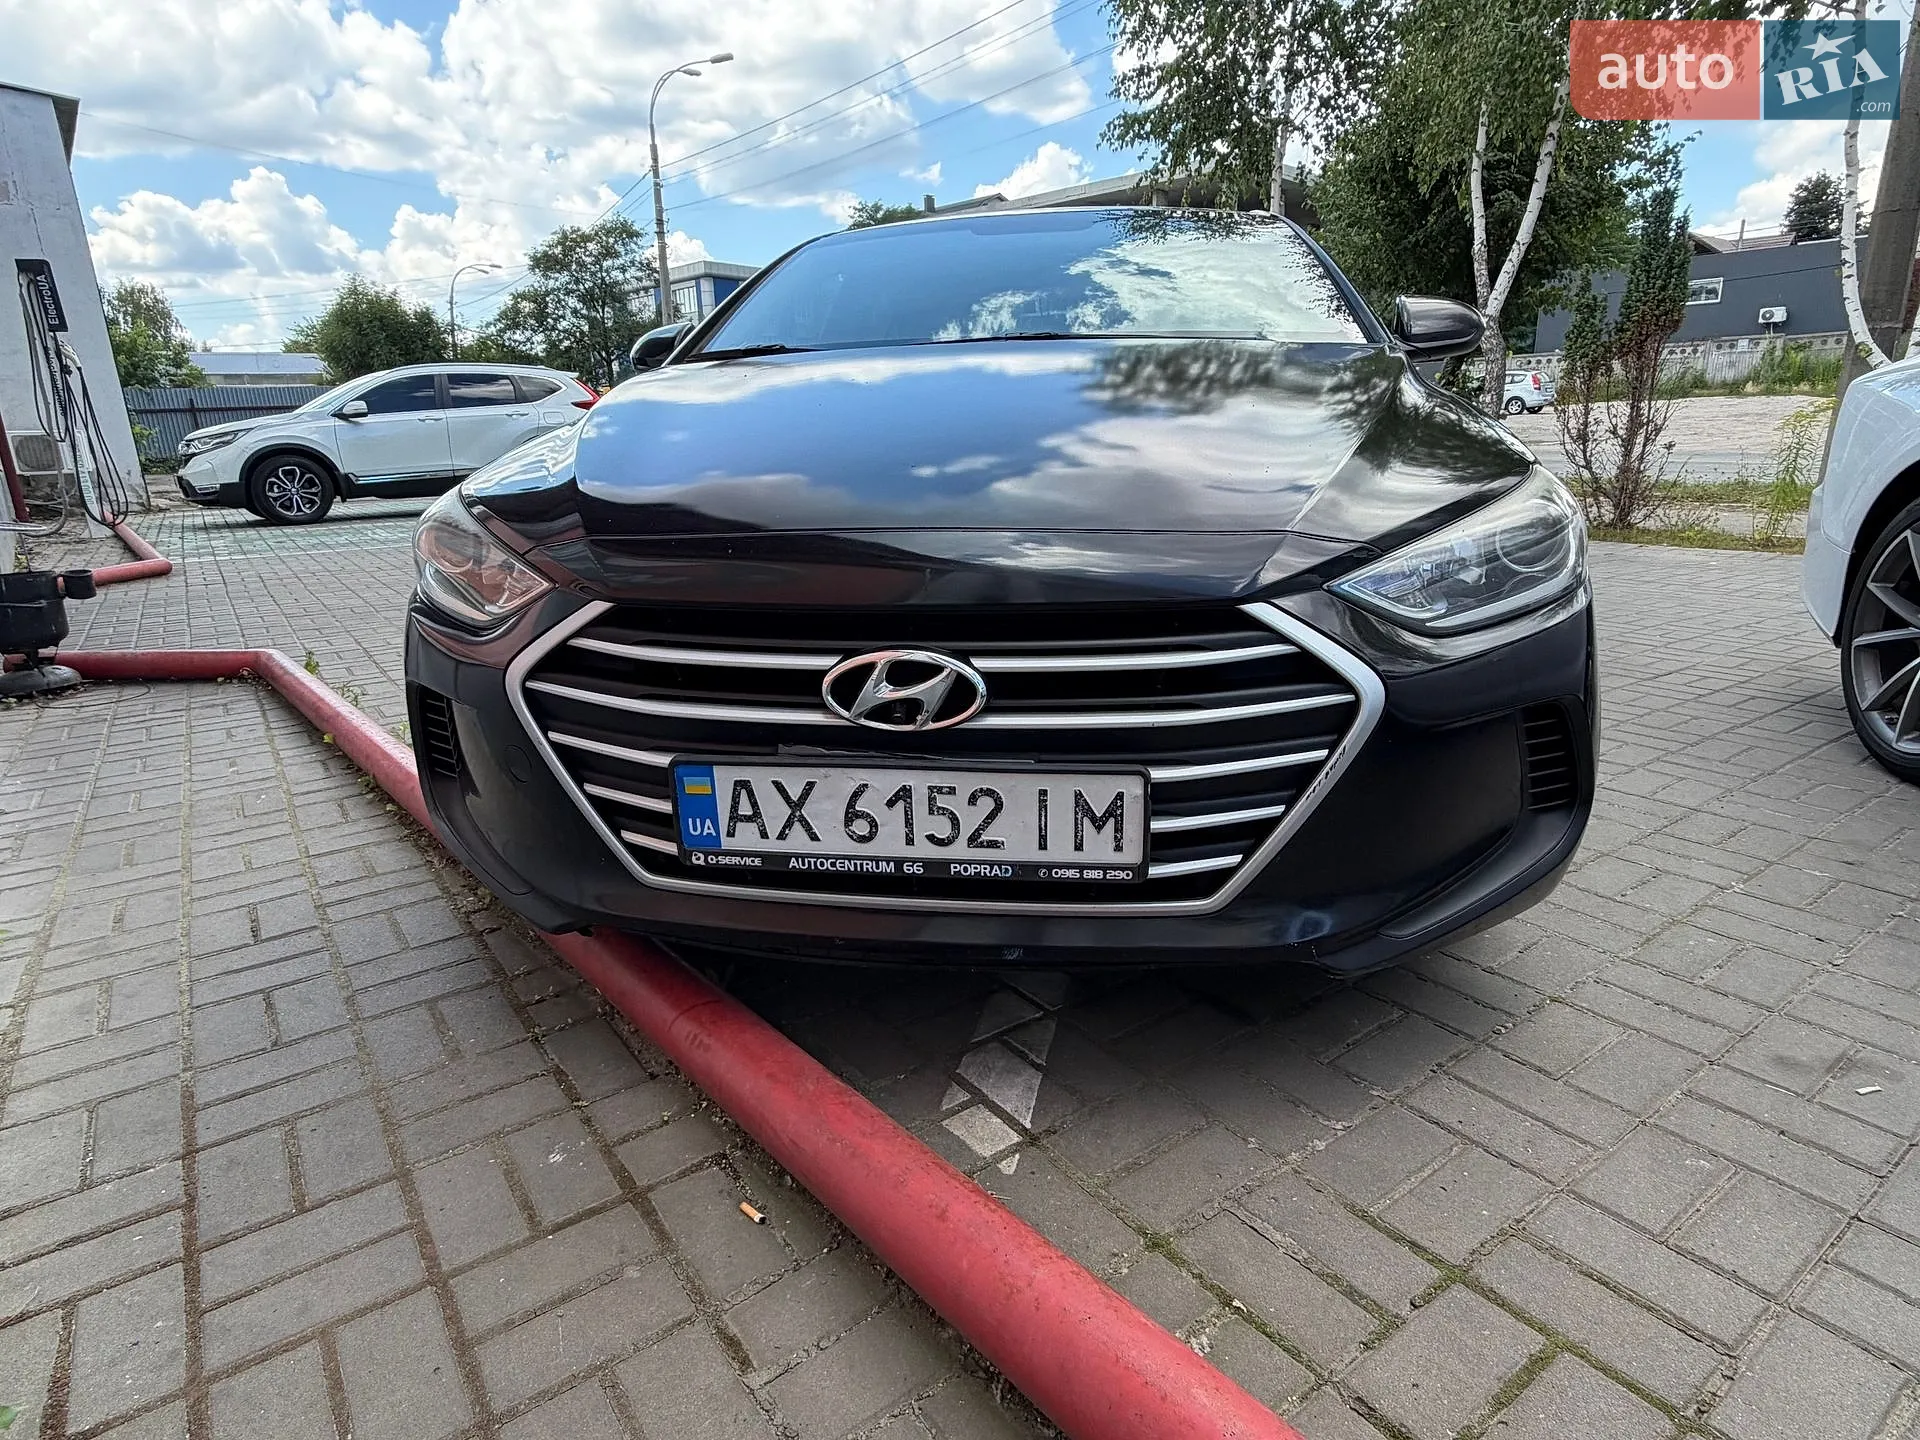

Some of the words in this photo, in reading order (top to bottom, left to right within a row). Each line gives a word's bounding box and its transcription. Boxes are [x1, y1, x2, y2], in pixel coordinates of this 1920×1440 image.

[36, 274, 59, 325] ElectroUA
[725, 778, 822, 841] AX
[843, 782, 1006, 850] 6152
[1037, 788, 1126, 853] IM
[688, 816, 717, 836] UA
[789, 858, 895, 875] AUTOCENTRUM
[903, 862, 924, 875] 66
[950, 863, 1012, 877] POPRAD
[1052, 867, 1080, 879] 0915
[1083, 868, 1103, 879] 818
[1106, 869, 1133, 880] 290
